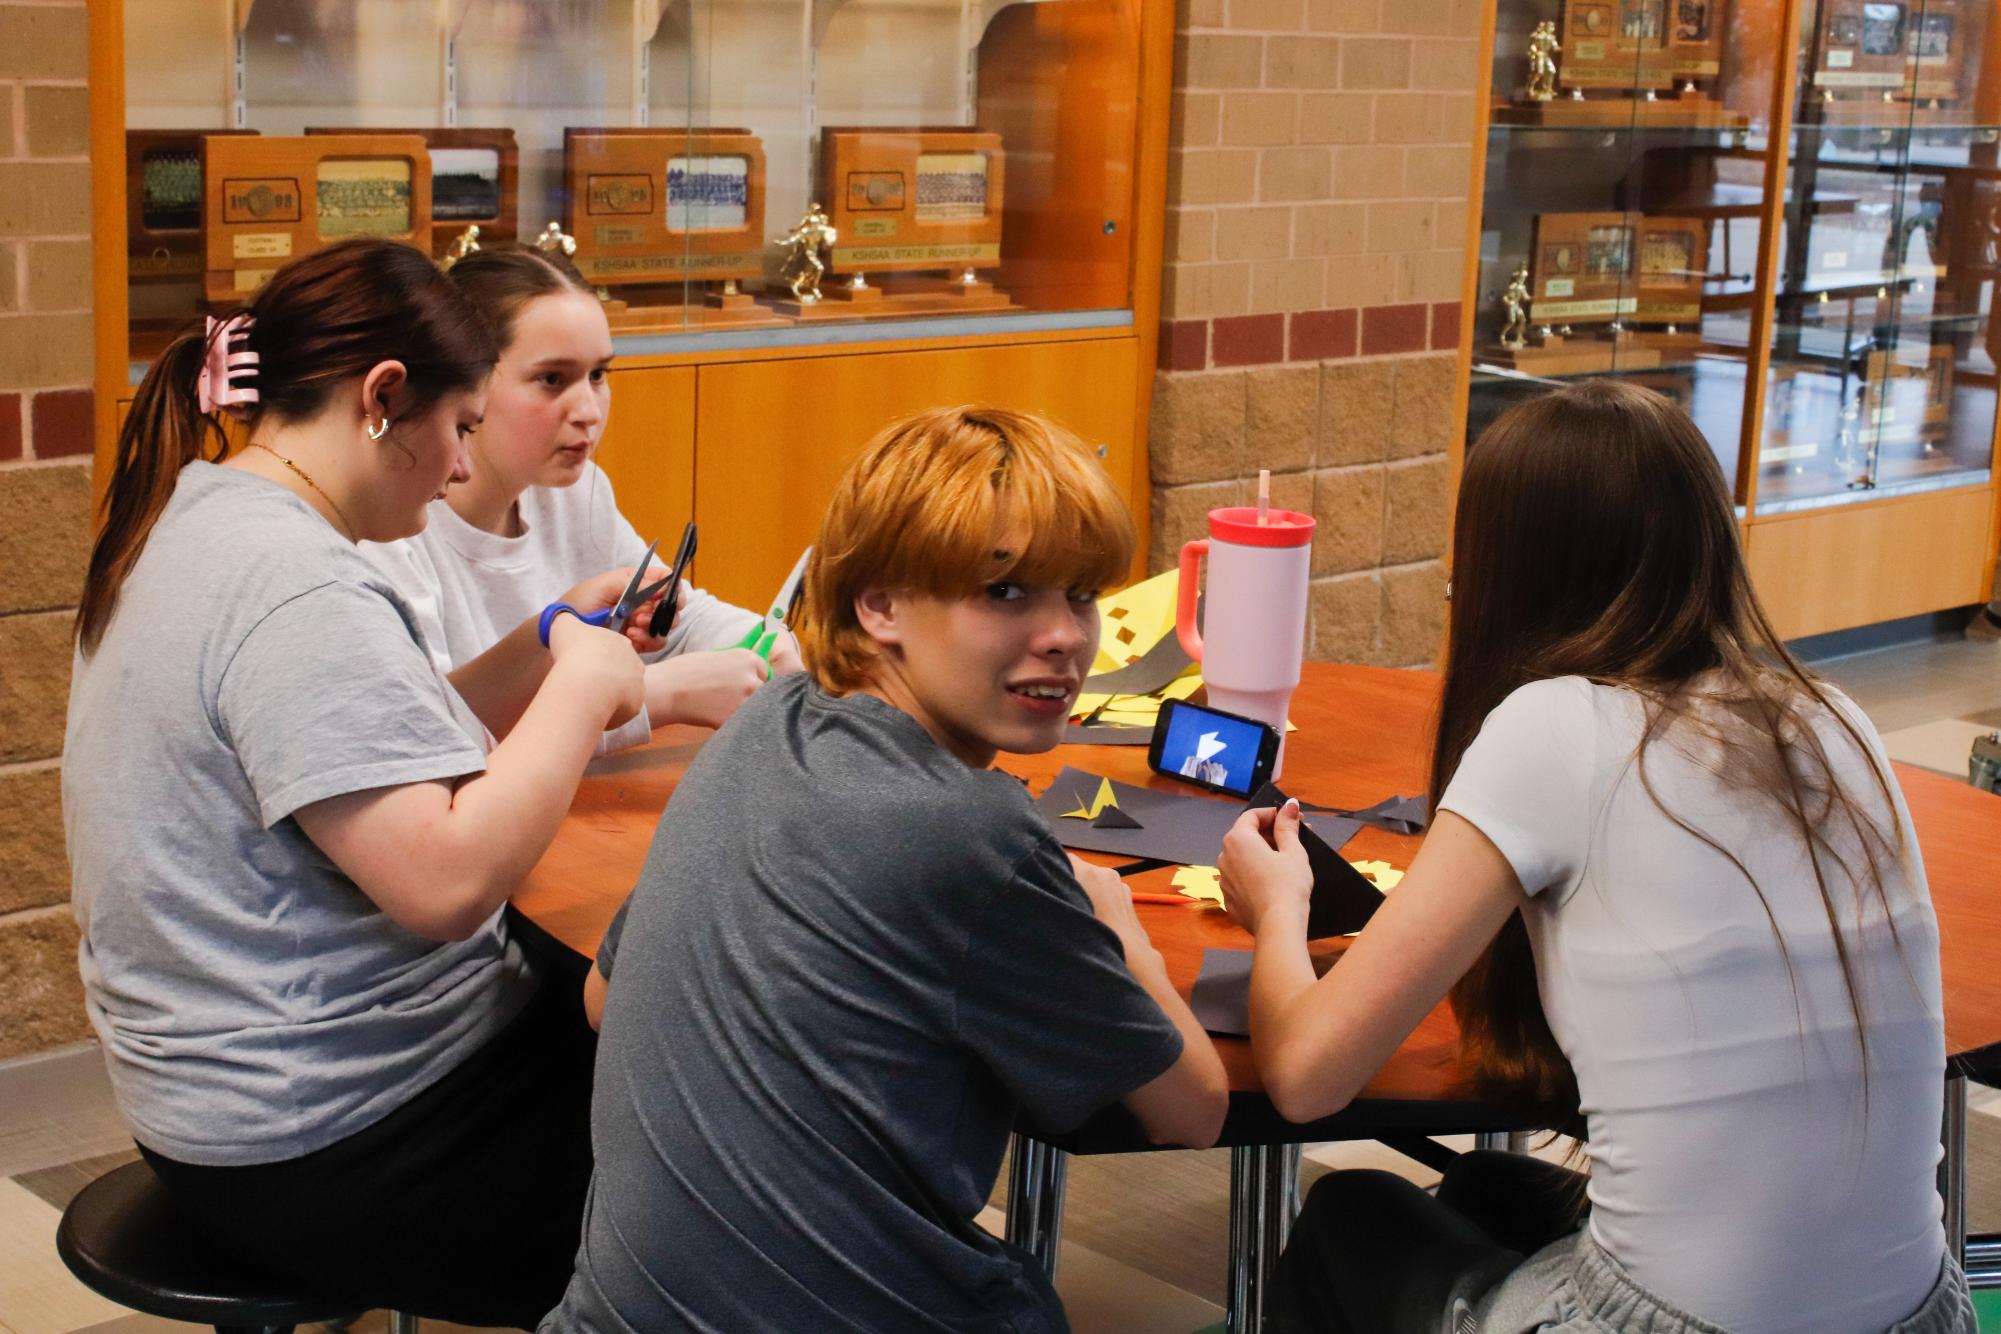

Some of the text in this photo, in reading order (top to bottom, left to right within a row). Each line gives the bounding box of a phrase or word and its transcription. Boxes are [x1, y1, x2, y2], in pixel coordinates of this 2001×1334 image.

[894, 248, 925, 259] STATE
[593, 260, 637, 271] KSHSAA
[642, 258, 674, 270] STATE
